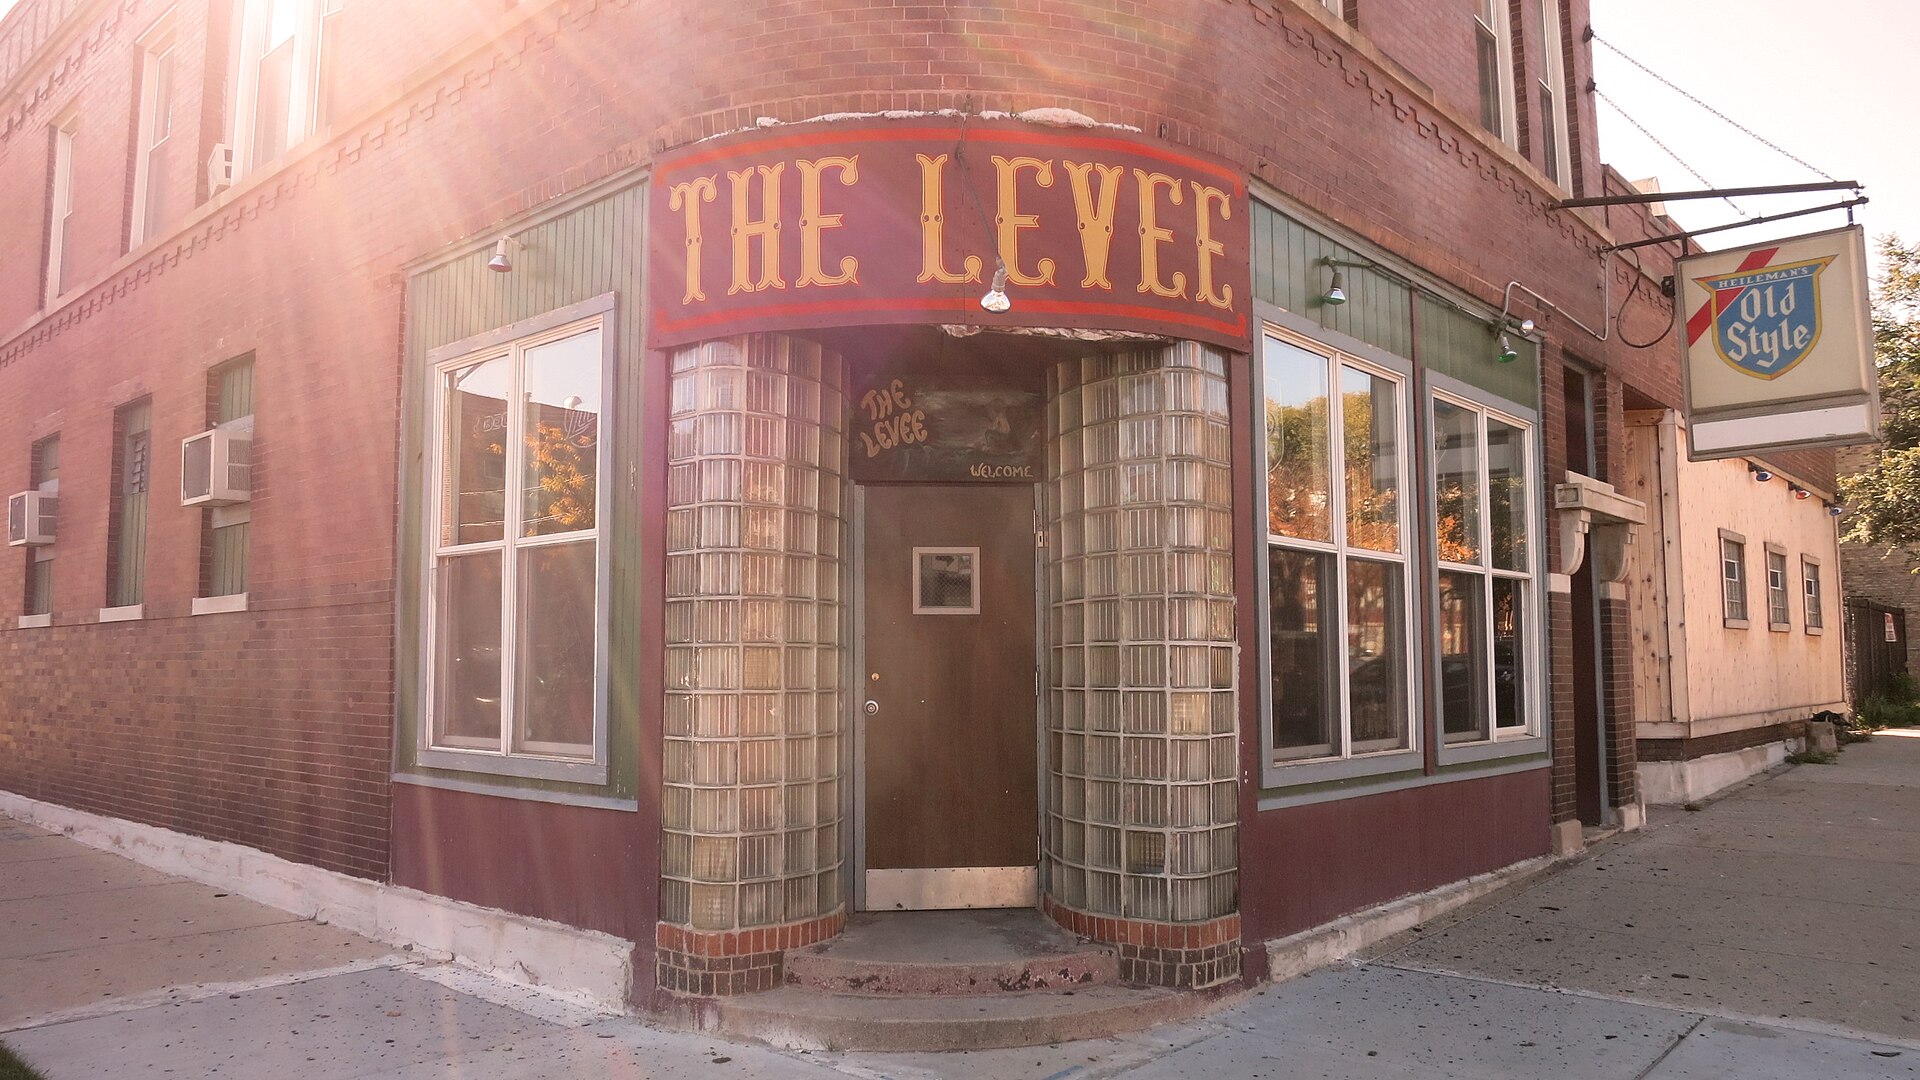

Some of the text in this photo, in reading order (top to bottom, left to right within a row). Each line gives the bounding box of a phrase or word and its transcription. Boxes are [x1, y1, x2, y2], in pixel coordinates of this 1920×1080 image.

[669, 154, 1233, 311] THE LEVEE
[1718, 267, 1809, 289] HEILEMAN'S
[1741, 281, 1796, 323] Old
[1727, 318, 1809, 368] Style
[861, 379, 911, 420] THE
[860, 409, 928, 458] LEVEE
[970, 462, 1034, 479] WELCOME
